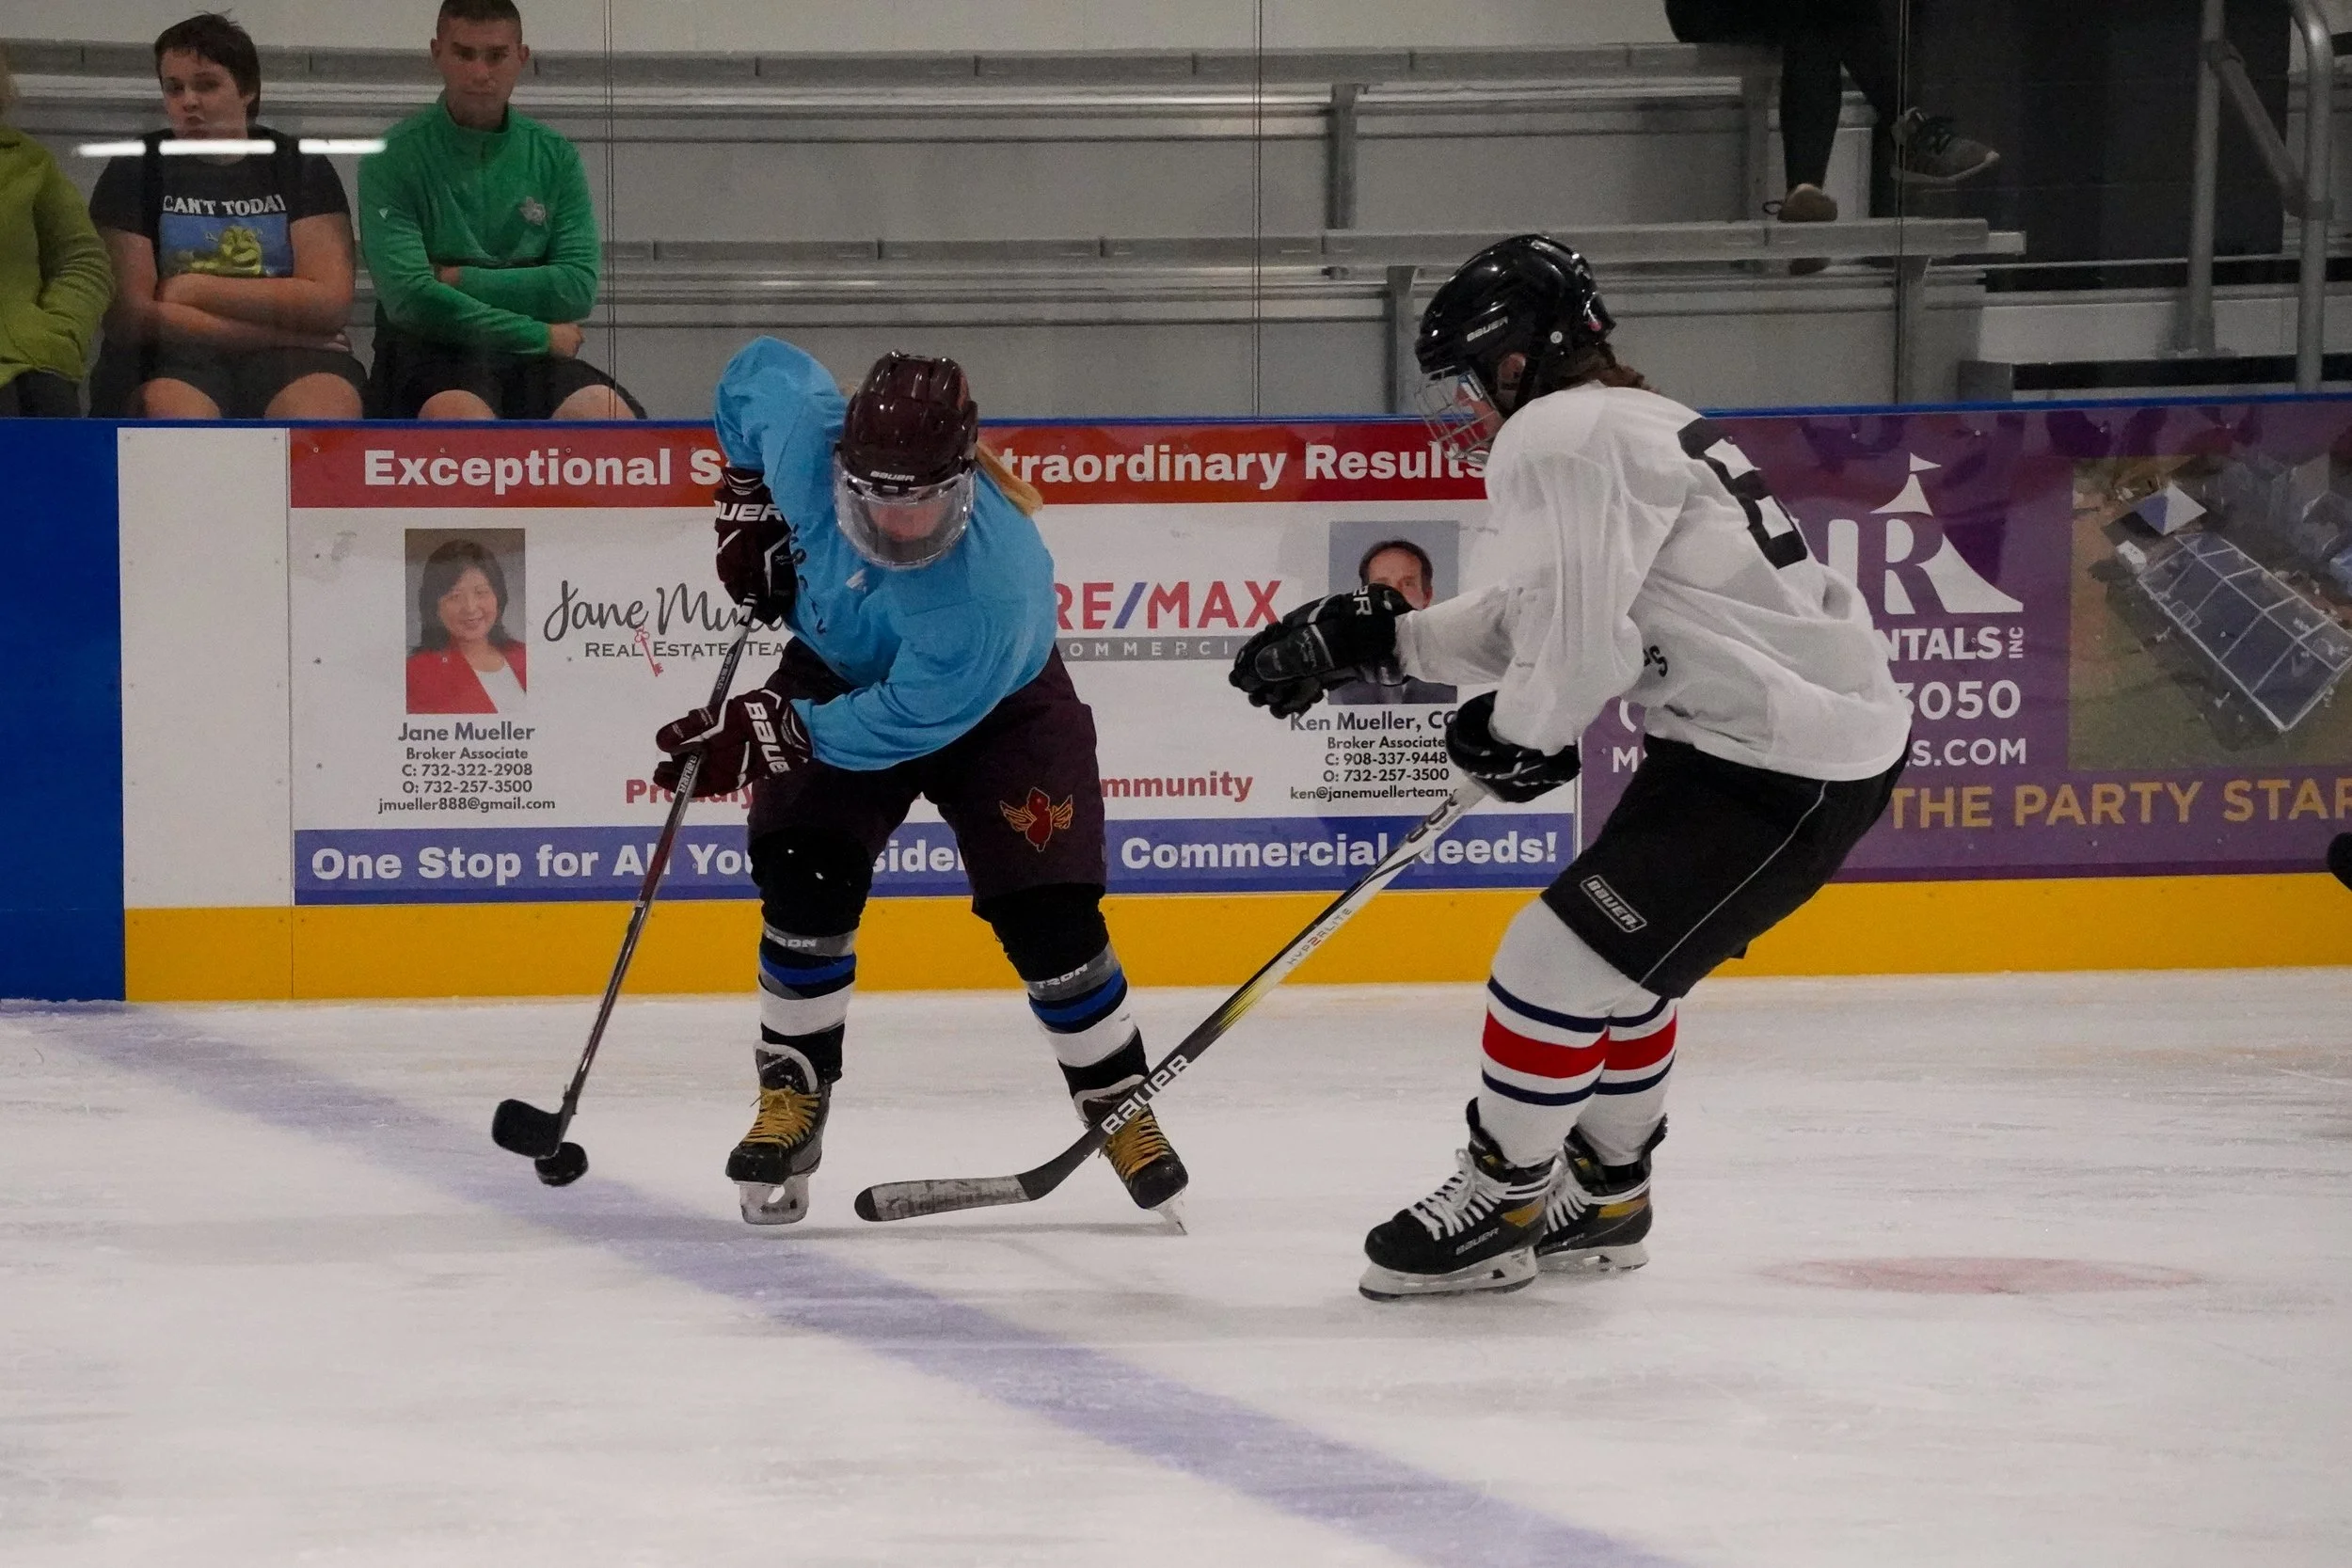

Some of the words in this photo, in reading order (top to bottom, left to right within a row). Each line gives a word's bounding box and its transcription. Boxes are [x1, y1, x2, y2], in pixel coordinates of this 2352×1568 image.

[364, 447, 671, 495] Exceptional
[1000, 444, 1287, 490] traordinary
[544, 580, 649, 641] Jane
[1053, 579, 1282, 630] RE/MAX
[584, 641, 644, 657] REAL
[653, 641, 730, 657] ESTATE
[744, 641, 784, 657] TEA
[1068, 641, 1229, 657] OMMERCI
[1872, 626, 2003, 660] NTALS
[2008, 626, 2024, 659] INC
[1896, 679, 2022, 721] 3050
[398, 721, 449, 741] Jane
[454, 721, 536, 741] Mueller
[1290, 712, 1331, 732] Ken
[1337, 710, 1422, 733] Mueller,
[406, 746, 456, 760] Broker
[459, 746, 529, 760] Associate
[1327, 736, 1375, 750] Broker
[1378, 735, 1446, 749] Associate
[1906, 737, 2027, 767] S.COM
[401, 763, 417, 777] C:
[421, 762, 533, 777] 732-322-2908
[1325, 752, 1340, 767] C:
[1343, 751, 1448, 766] 908-337-9448
[1101, 770, 1254, 802] mmunity
[1323, 769, 1340, 783] O:
[1343, 768, 1450, 783] 732-257-3500
[402, 781, 419, 794] O:
[423, 780, 533, 794] 732-257-3500
[1290, 784, 1454, 802] ken@janemuellerteam.
[377, 797, 556, 815] jmueller888@gmail.com
[1891, 785, 1993, 829] THE
[2014, 781, 2203, 826] PARTY
[311, 847, 403, 880] One
[418, 846, 522, 886] Stop
[535, 844, 599, 877] for
[687, 844, 753, 876] Yo
[1120, 832, 1390, 871] Commercial
[1100, 1053, 1191, 1135] BAUER
